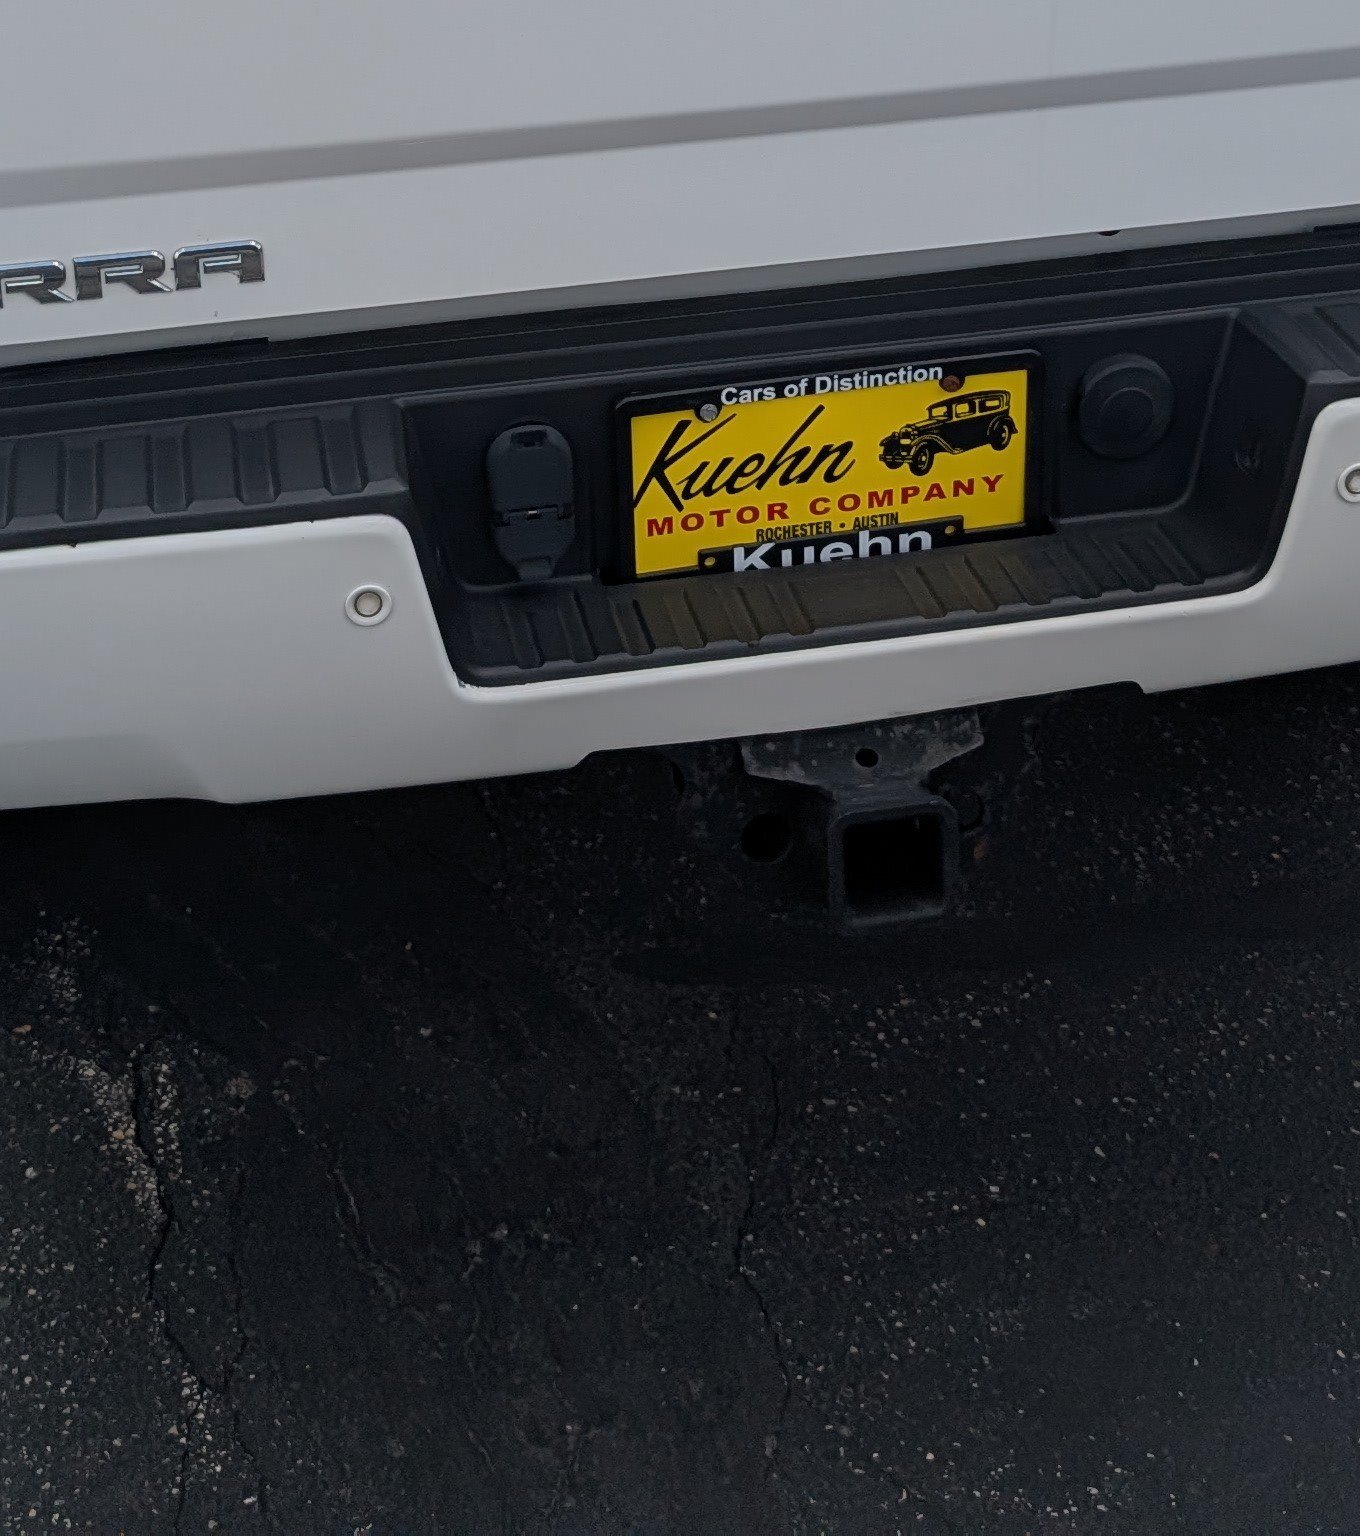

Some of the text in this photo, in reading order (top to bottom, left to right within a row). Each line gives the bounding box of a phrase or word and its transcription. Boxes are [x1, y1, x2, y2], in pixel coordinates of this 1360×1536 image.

[720, 365, 943, 406] Cars of Distinction
[633, 404, 857, 513] Kuehn
[647, 473, 1005, 538] MOTOR COMPANY
[755, 512, 900, 543] ROCHESTER AUSTIN
[733, 529, 933, 573] Kuehn
